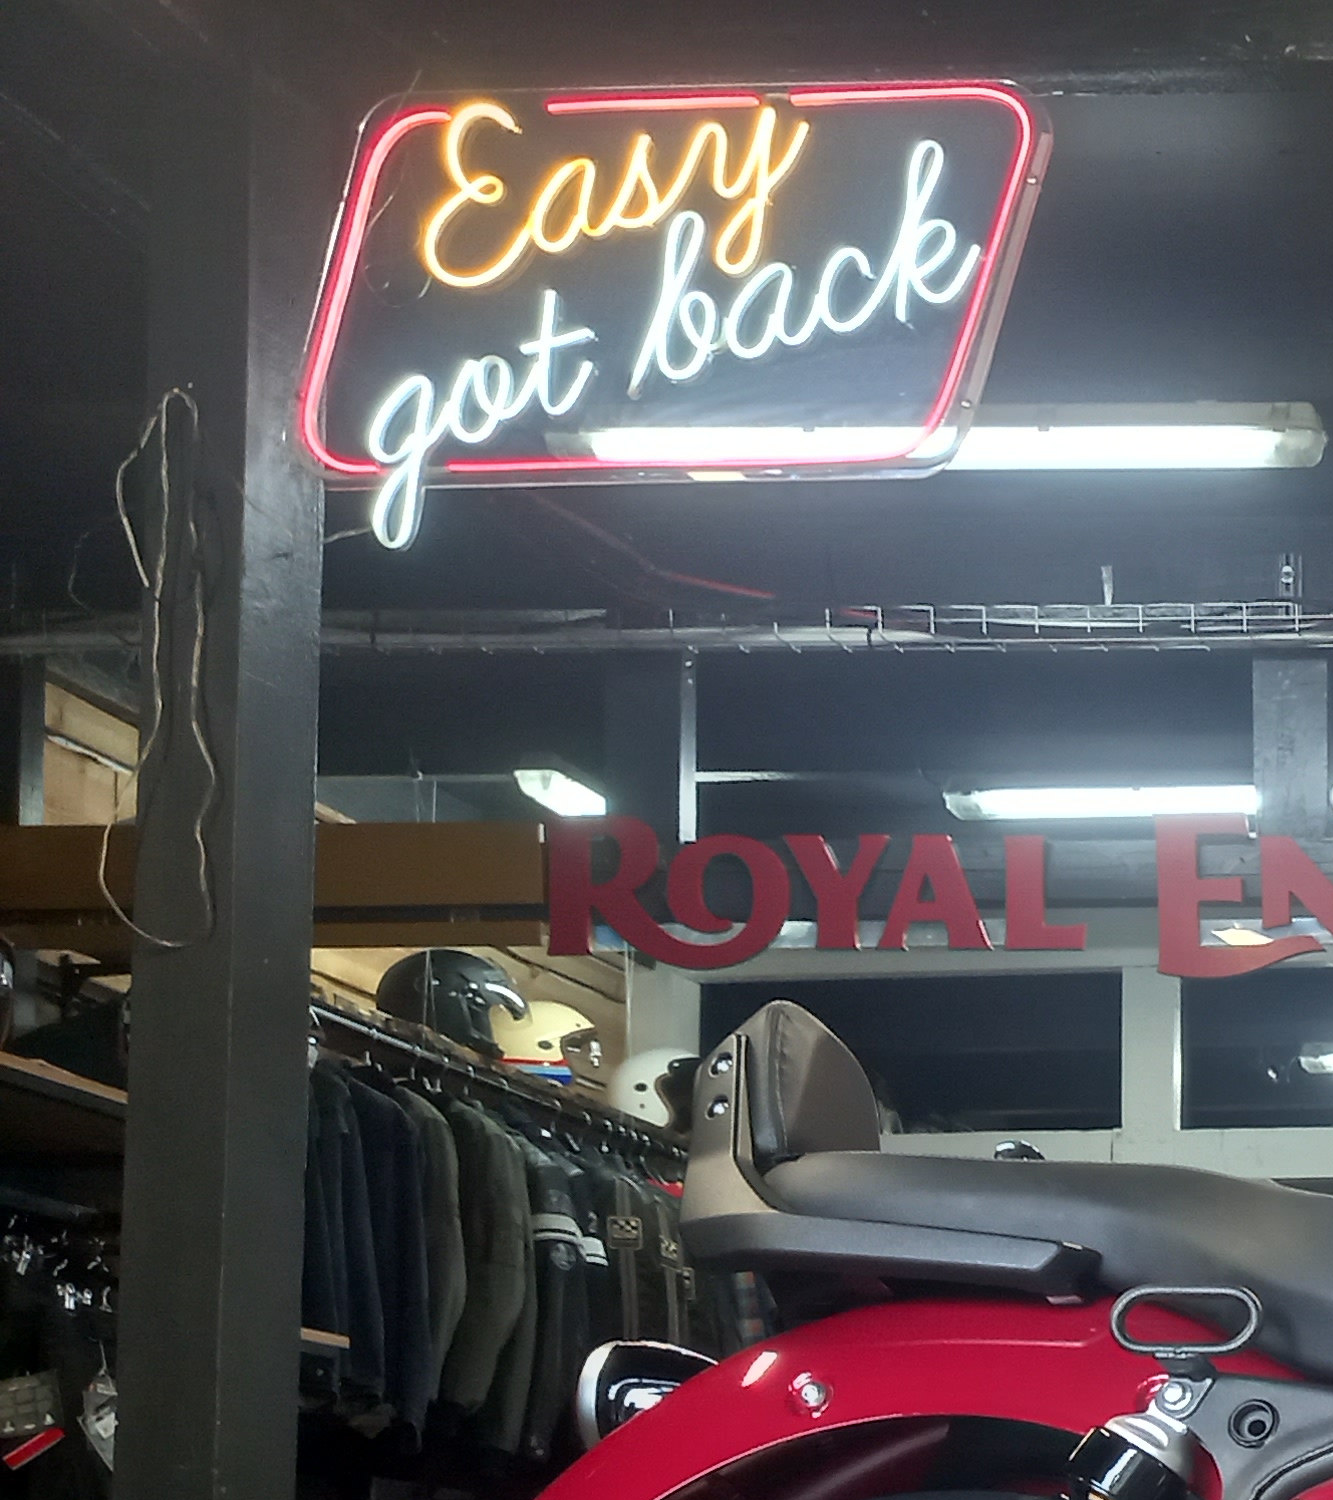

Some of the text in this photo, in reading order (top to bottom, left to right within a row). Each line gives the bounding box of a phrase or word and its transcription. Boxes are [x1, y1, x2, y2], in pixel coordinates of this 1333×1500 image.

[421, 98, 811, 288] Easy
[367, 138, 982, 550] got back
[546, 814, 1087, 970] ROYAL
